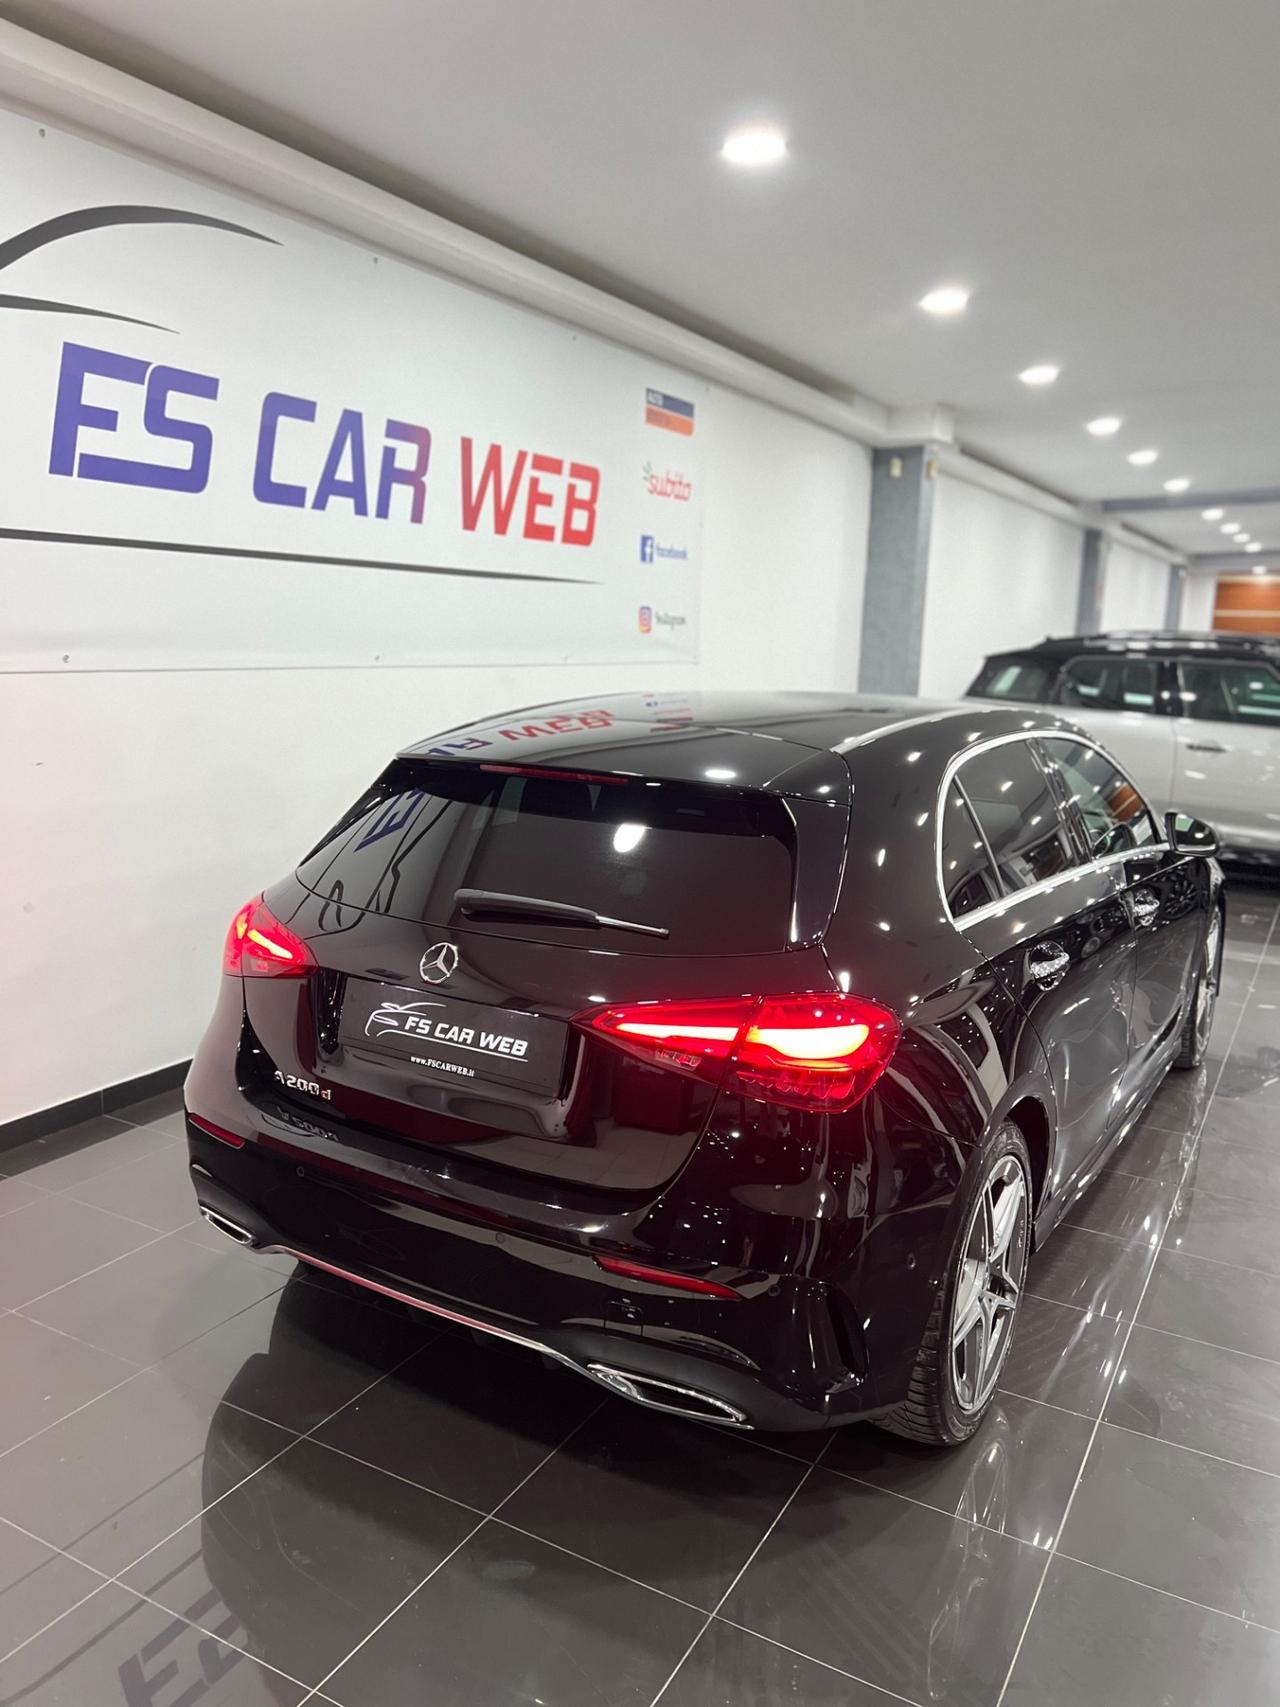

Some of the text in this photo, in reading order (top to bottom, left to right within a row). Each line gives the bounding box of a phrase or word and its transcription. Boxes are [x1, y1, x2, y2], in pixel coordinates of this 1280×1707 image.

[48, 341, 600, 547] FS CAR WEB
[404, 1015, 529, 1057] FS CAR WEB
[286, 1074, 320, 1096] 200
